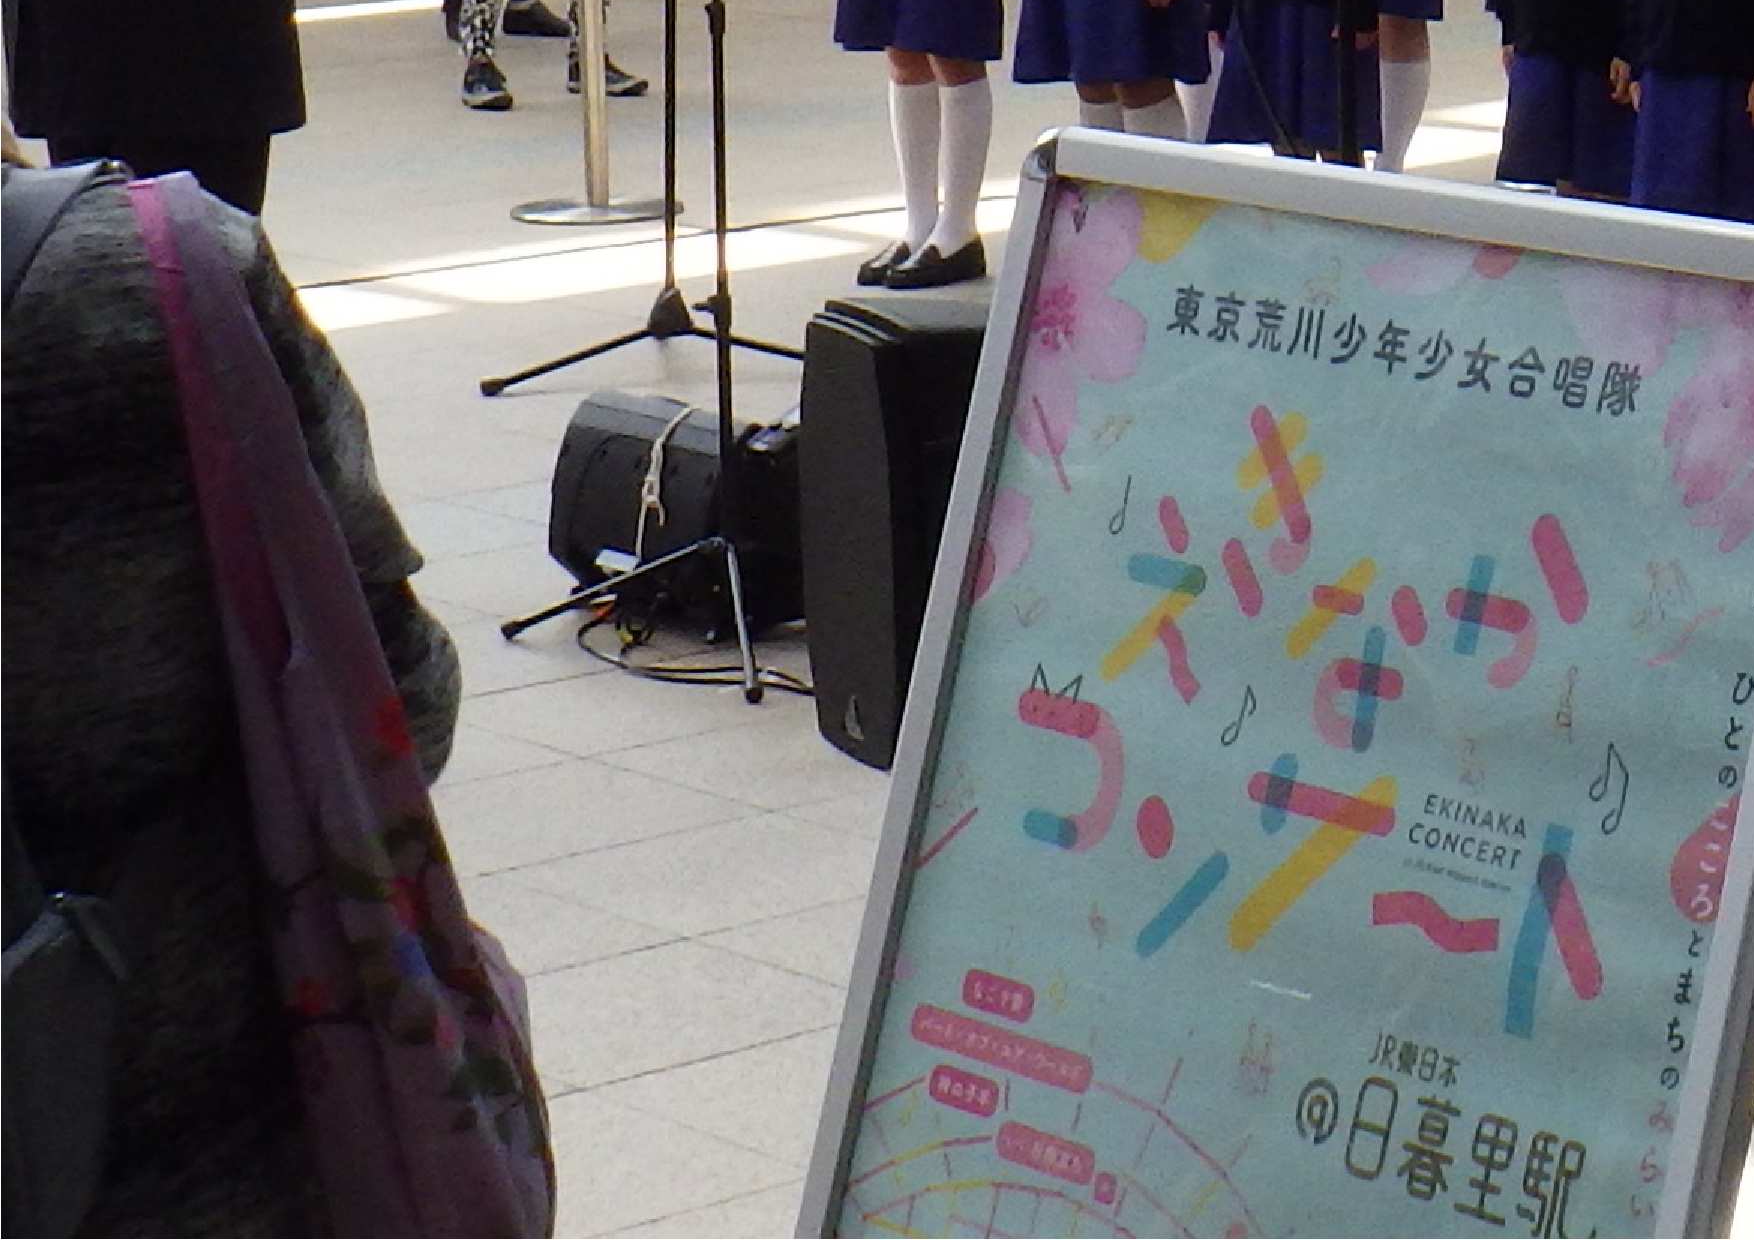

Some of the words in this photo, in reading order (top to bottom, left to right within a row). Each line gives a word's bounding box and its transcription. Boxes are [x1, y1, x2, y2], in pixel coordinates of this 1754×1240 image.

[1166, 283, 1643, 418] 東京荒川少年少女合唱隊
[1424, 793, 1527, 840] EKINAKA
[1408, 822, 1522, 870] CONCERT
[1368, 1027, 1461, 1087] JR東日本
